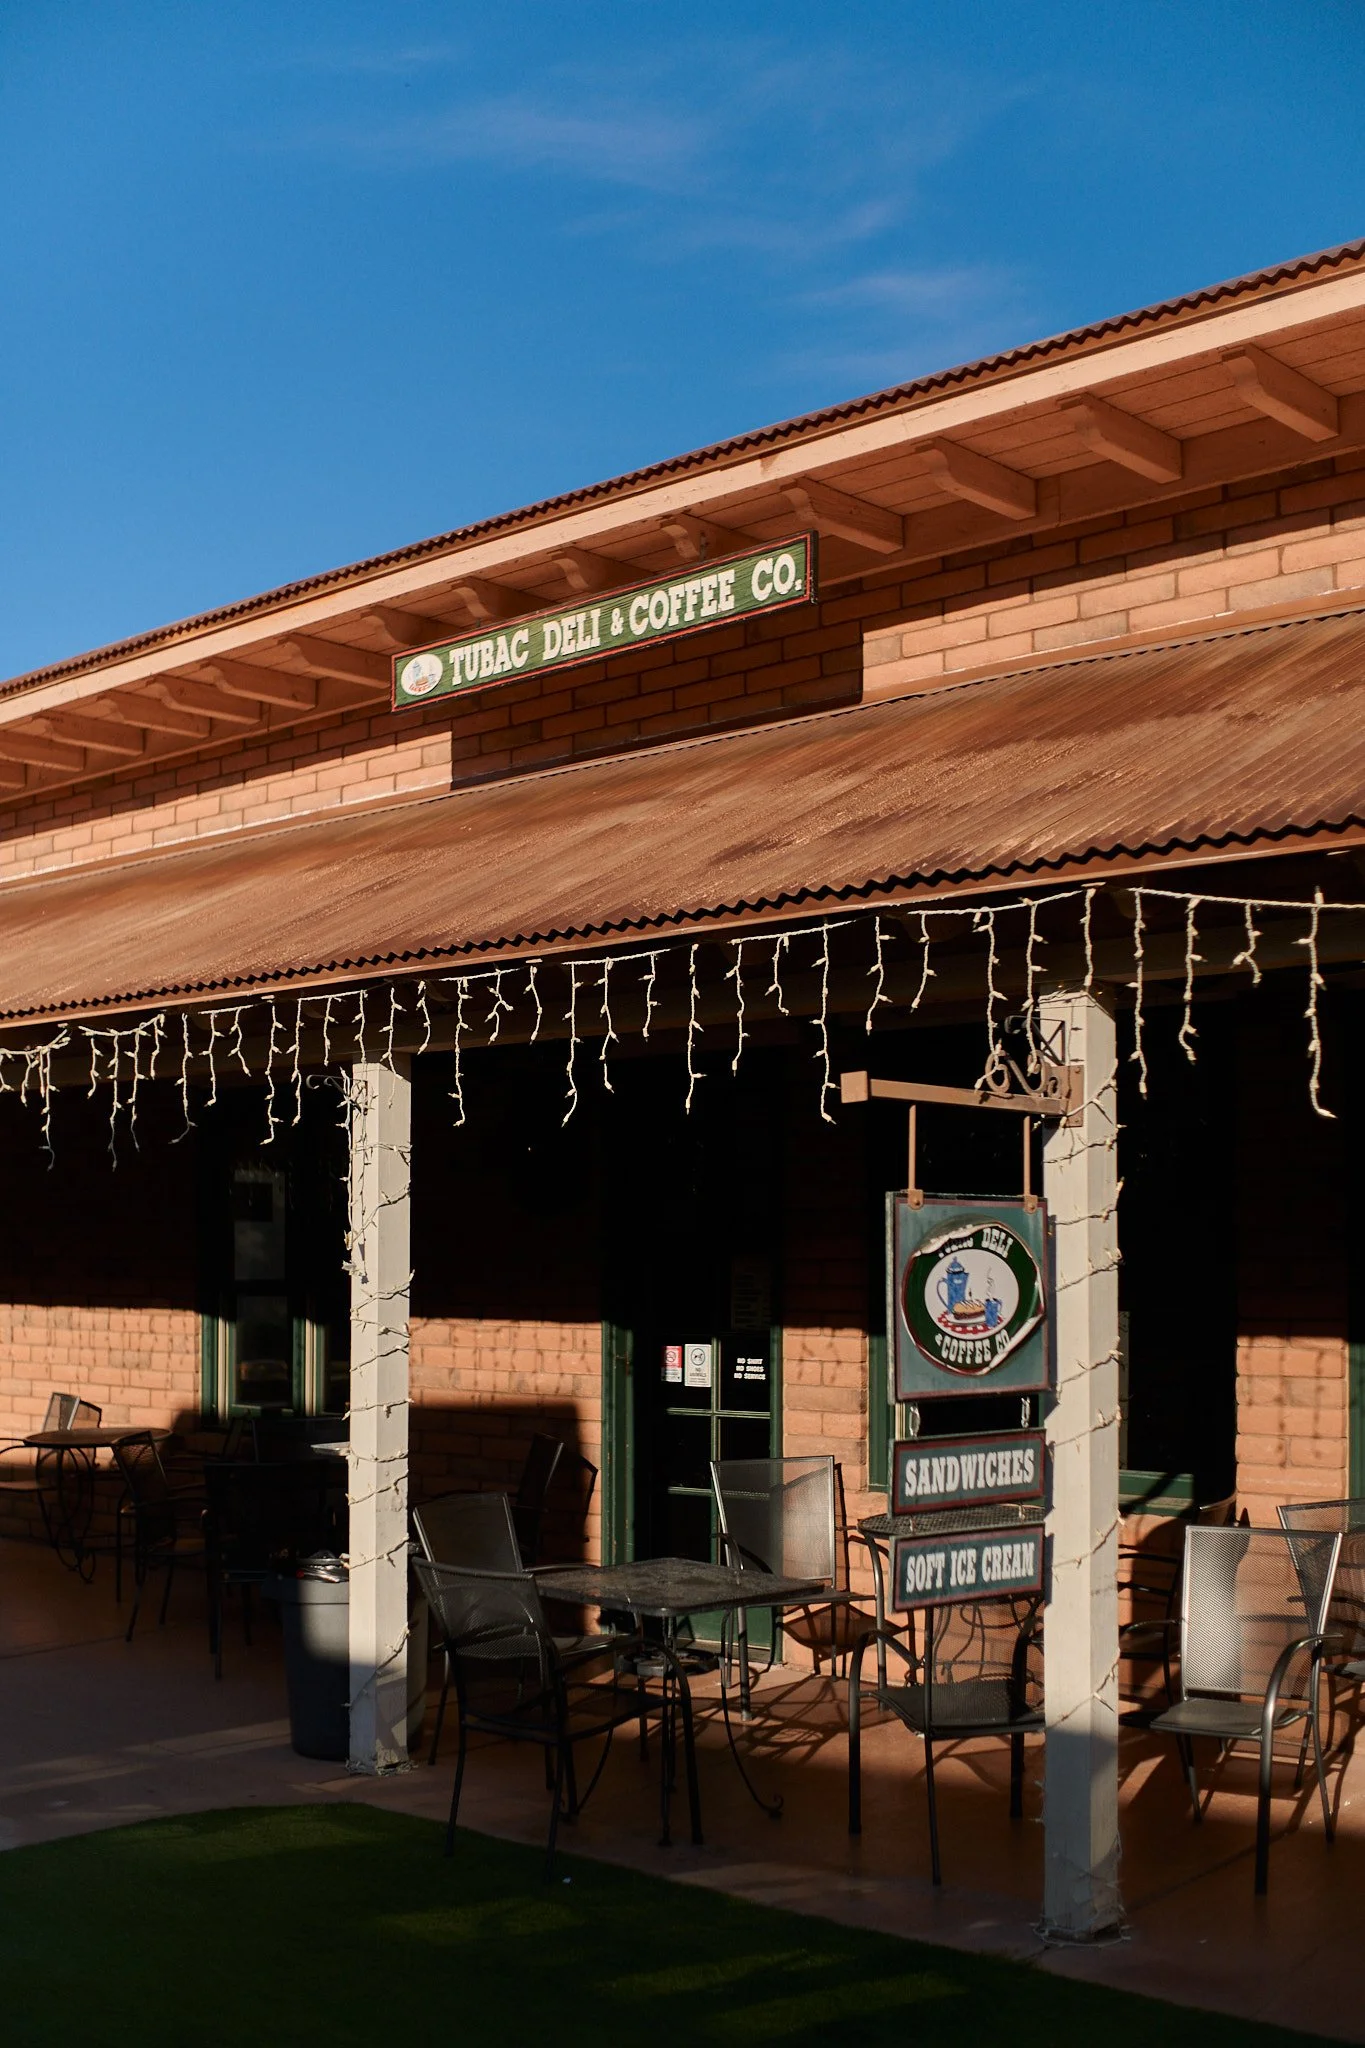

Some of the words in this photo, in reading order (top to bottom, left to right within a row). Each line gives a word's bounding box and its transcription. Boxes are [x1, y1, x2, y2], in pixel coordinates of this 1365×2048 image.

[449, 629, 530, 685] TUBAC
[543, 607, 601, 661] DELI
[610, 607, 624, 637] &
[629, 569, 736, 636] COFFEE
[751, 553, 802, 602] CO.
[982, 1228, 1013, 1258] DELI
[941, 1338, 992, 1364] COFFEE
[905, 1448, 1034, 1497] SANDWICHES
[907, 1552, 945, 1593] SOFT
[950, 1548, 976, 1586] ICE
[982, 1542, 1034, 1582] CREAM
